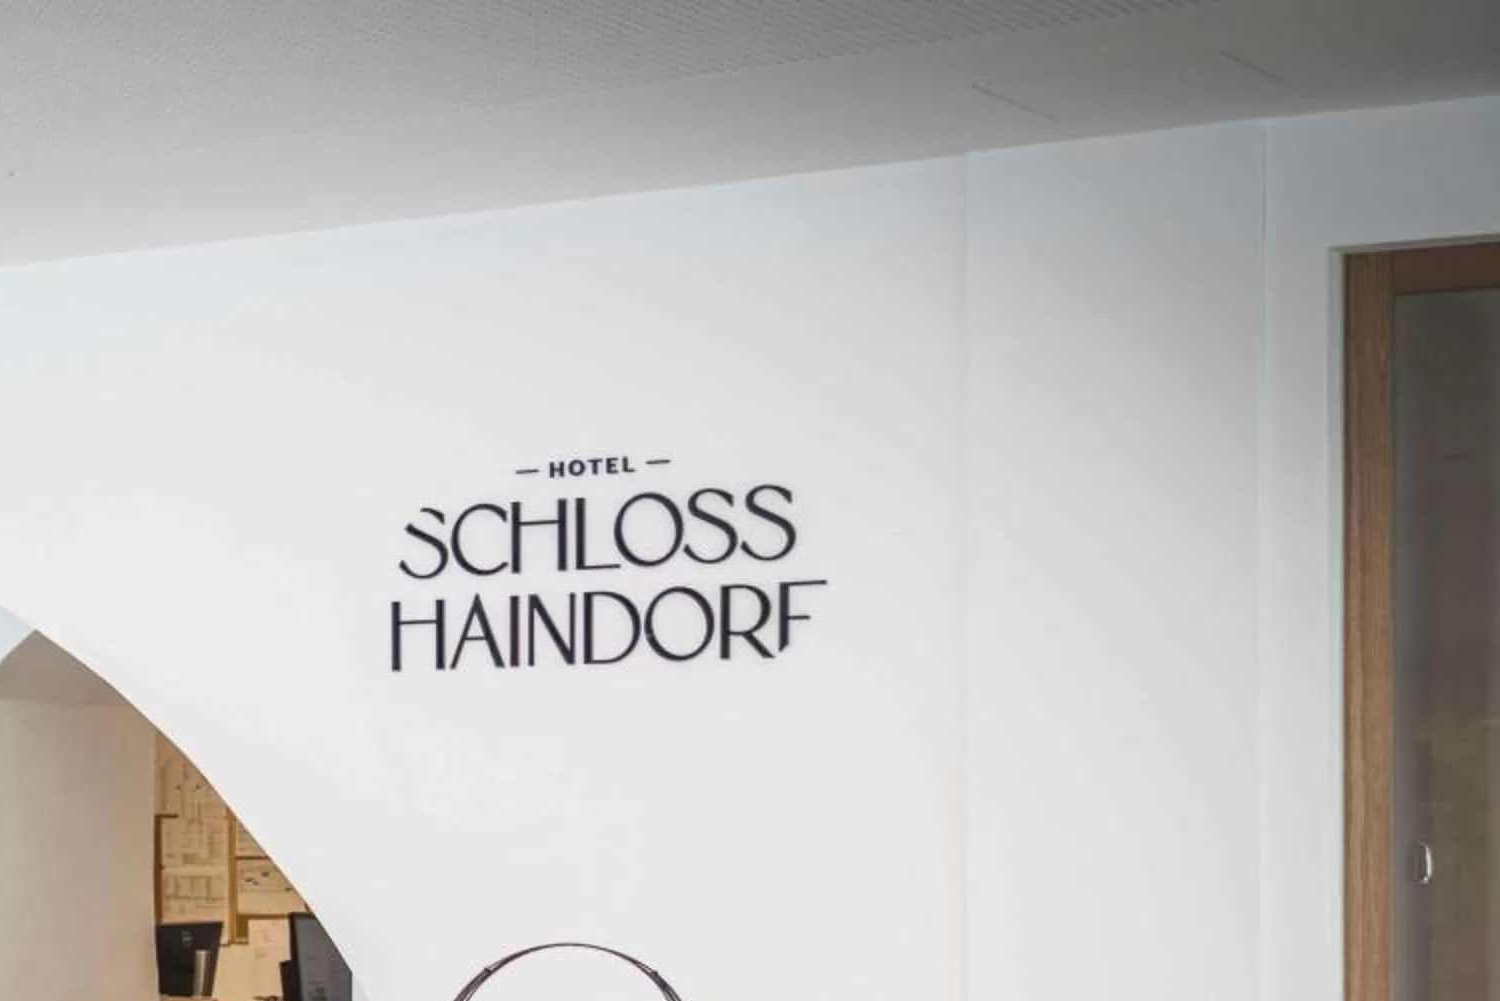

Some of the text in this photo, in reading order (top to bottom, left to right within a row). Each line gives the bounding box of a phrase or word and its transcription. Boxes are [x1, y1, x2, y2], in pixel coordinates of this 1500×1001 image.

[549, 456, 635, 479] HOTEL
[399, 484, 797, 580] SCHLOSS
[391, 579, 827, 672] HAINDORF
